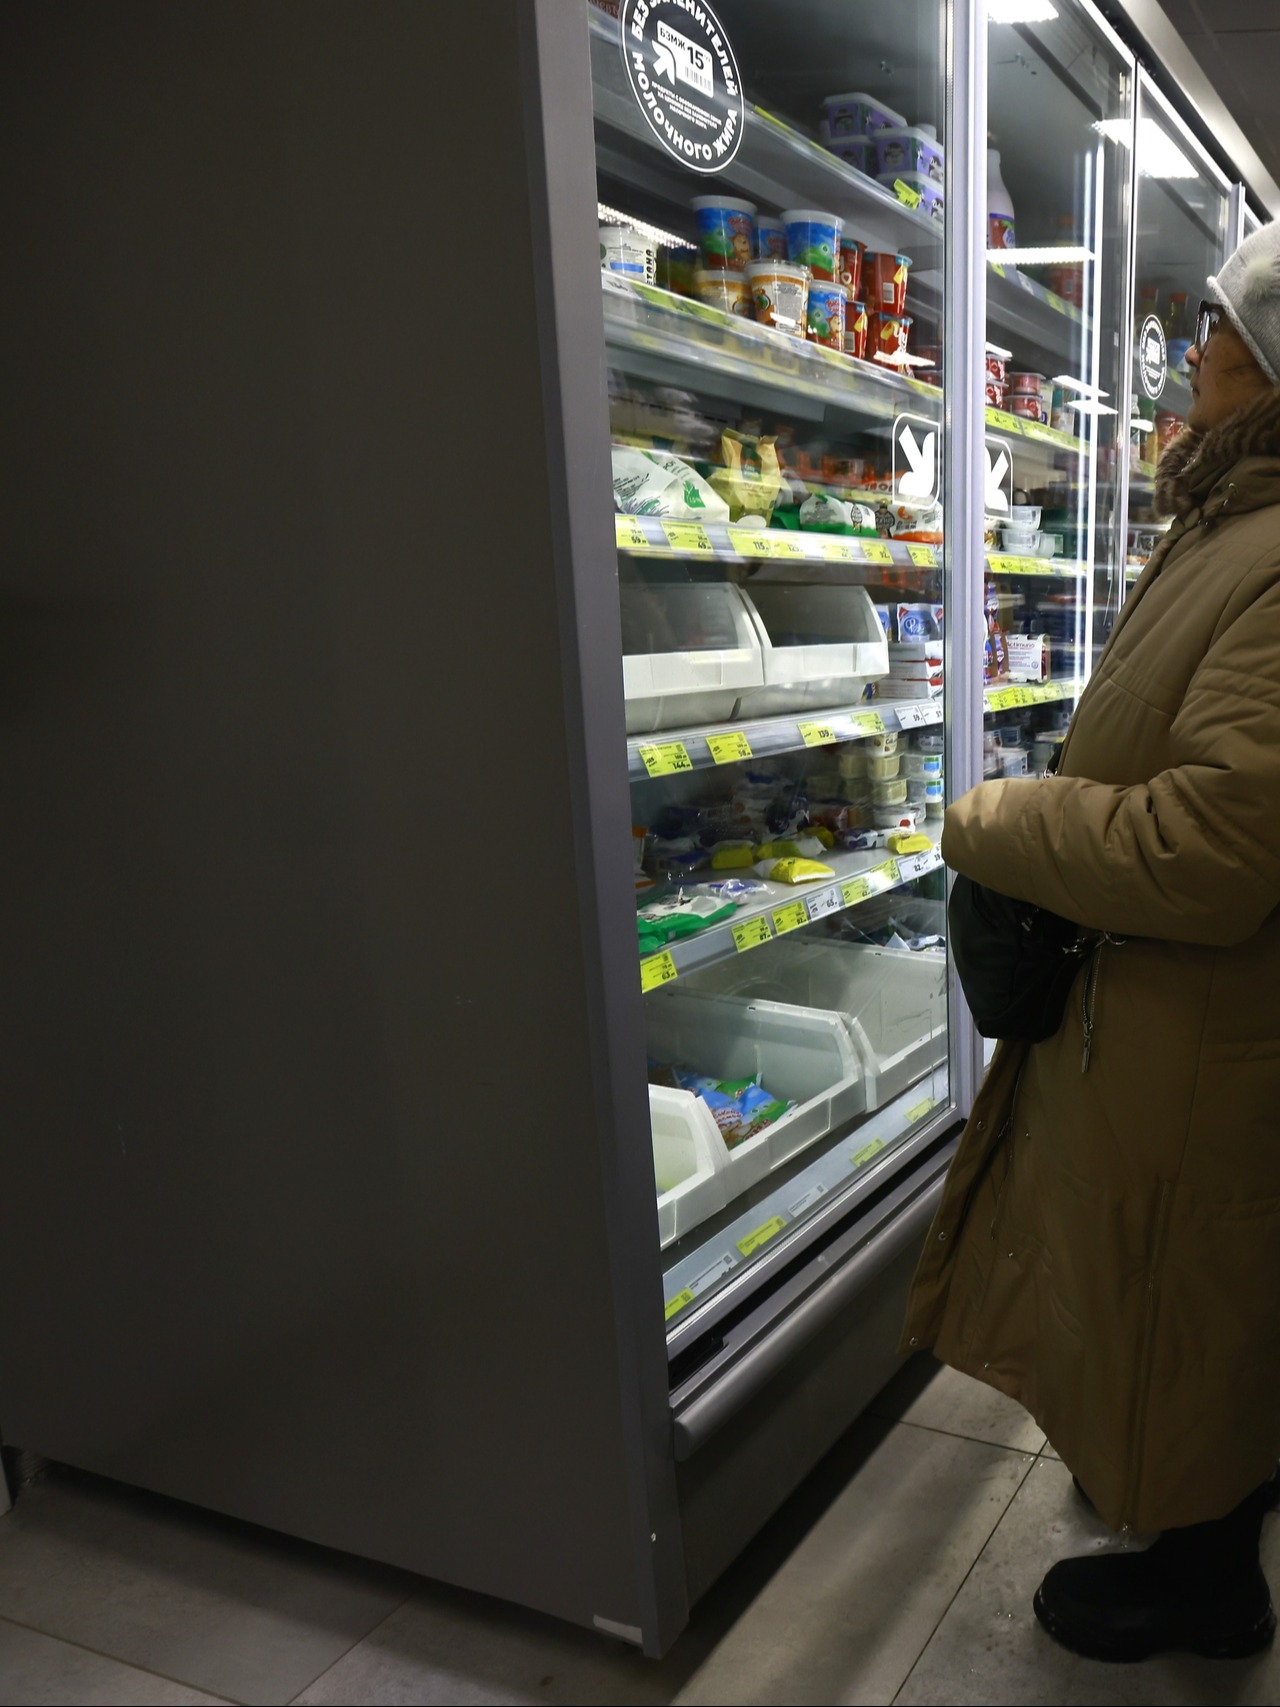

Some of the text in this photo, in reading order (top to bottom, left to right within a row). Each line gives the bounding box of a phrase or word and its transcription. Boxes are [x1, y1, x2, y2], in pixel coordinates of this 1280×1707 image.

[631, 0, 650, 42] БЕЗ
[660, 27, 685, 51] БЗМЖ
[687, 45, 704, 70] 15
[632, 51, 738, 160] МОЛОЧНОГО ЖИРА
